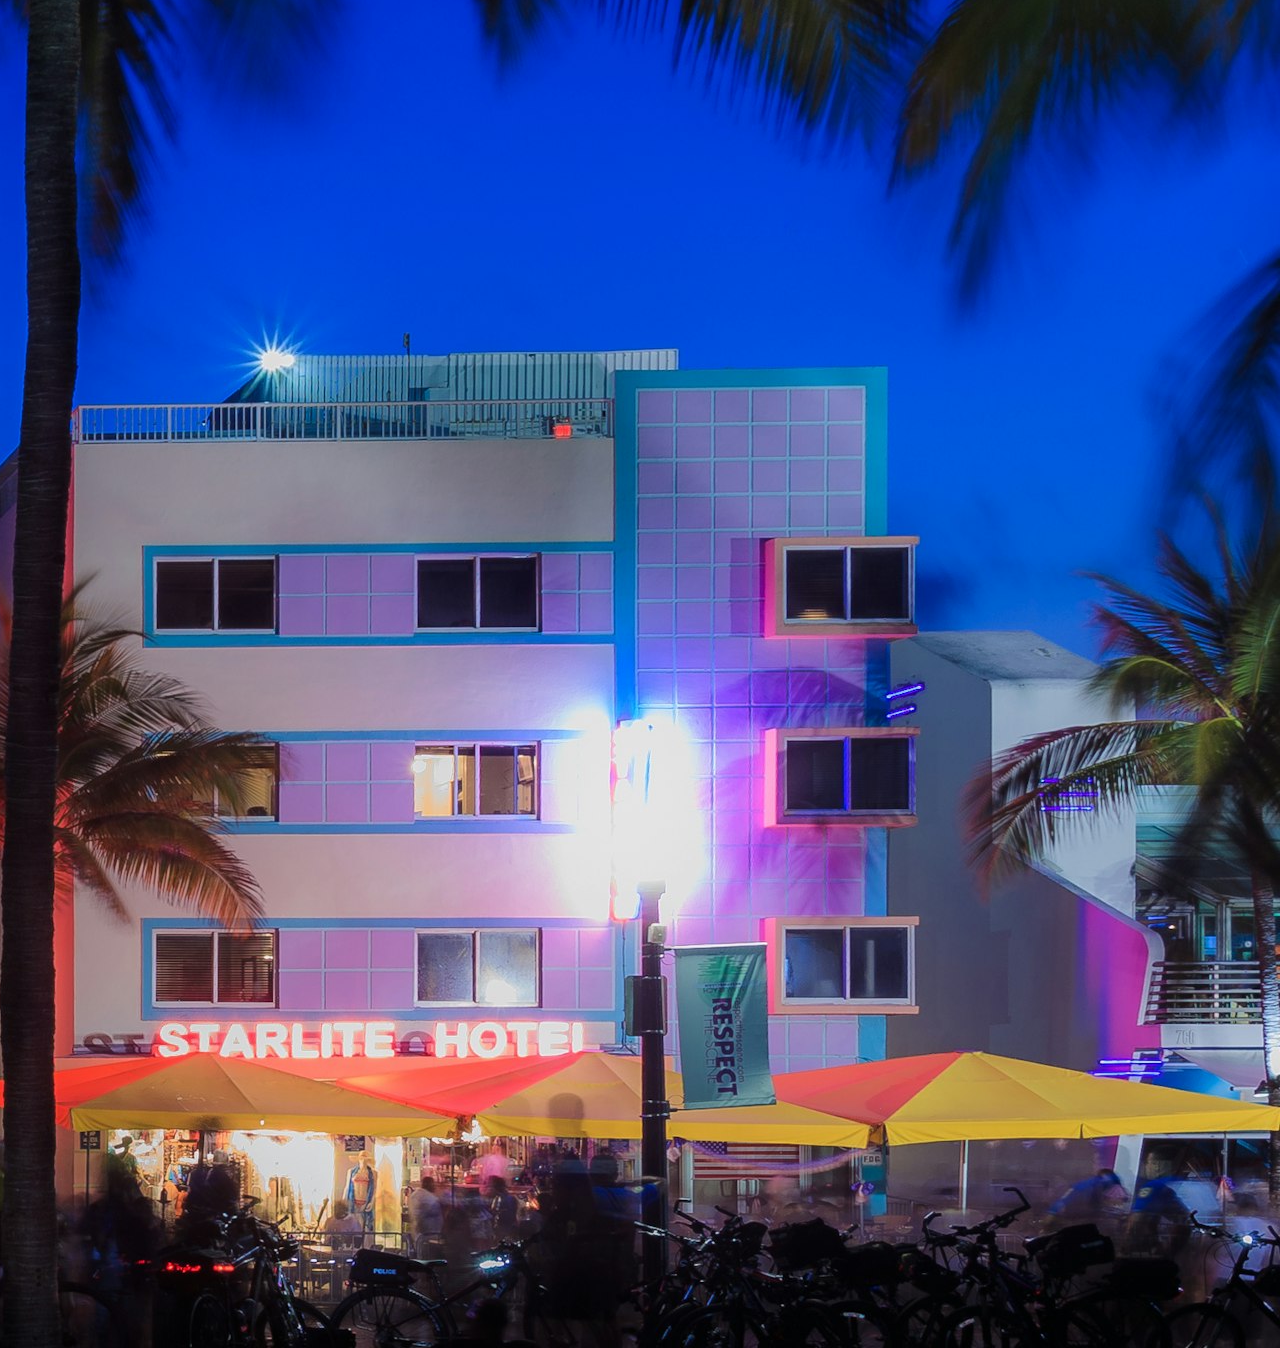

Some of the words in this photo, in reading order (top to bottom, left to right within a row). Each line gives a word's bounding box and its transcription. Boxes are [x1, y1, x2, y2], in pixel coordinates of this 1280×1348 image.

[157, 1022, 395, 1059] STARLITE
[704, 1014, 715, 1035] THE
[705, 1040, 719, 1085] SCENE
[712, 998, 738, 1096] RESPECT
[373, 1266, 397, 1276] POLICE
